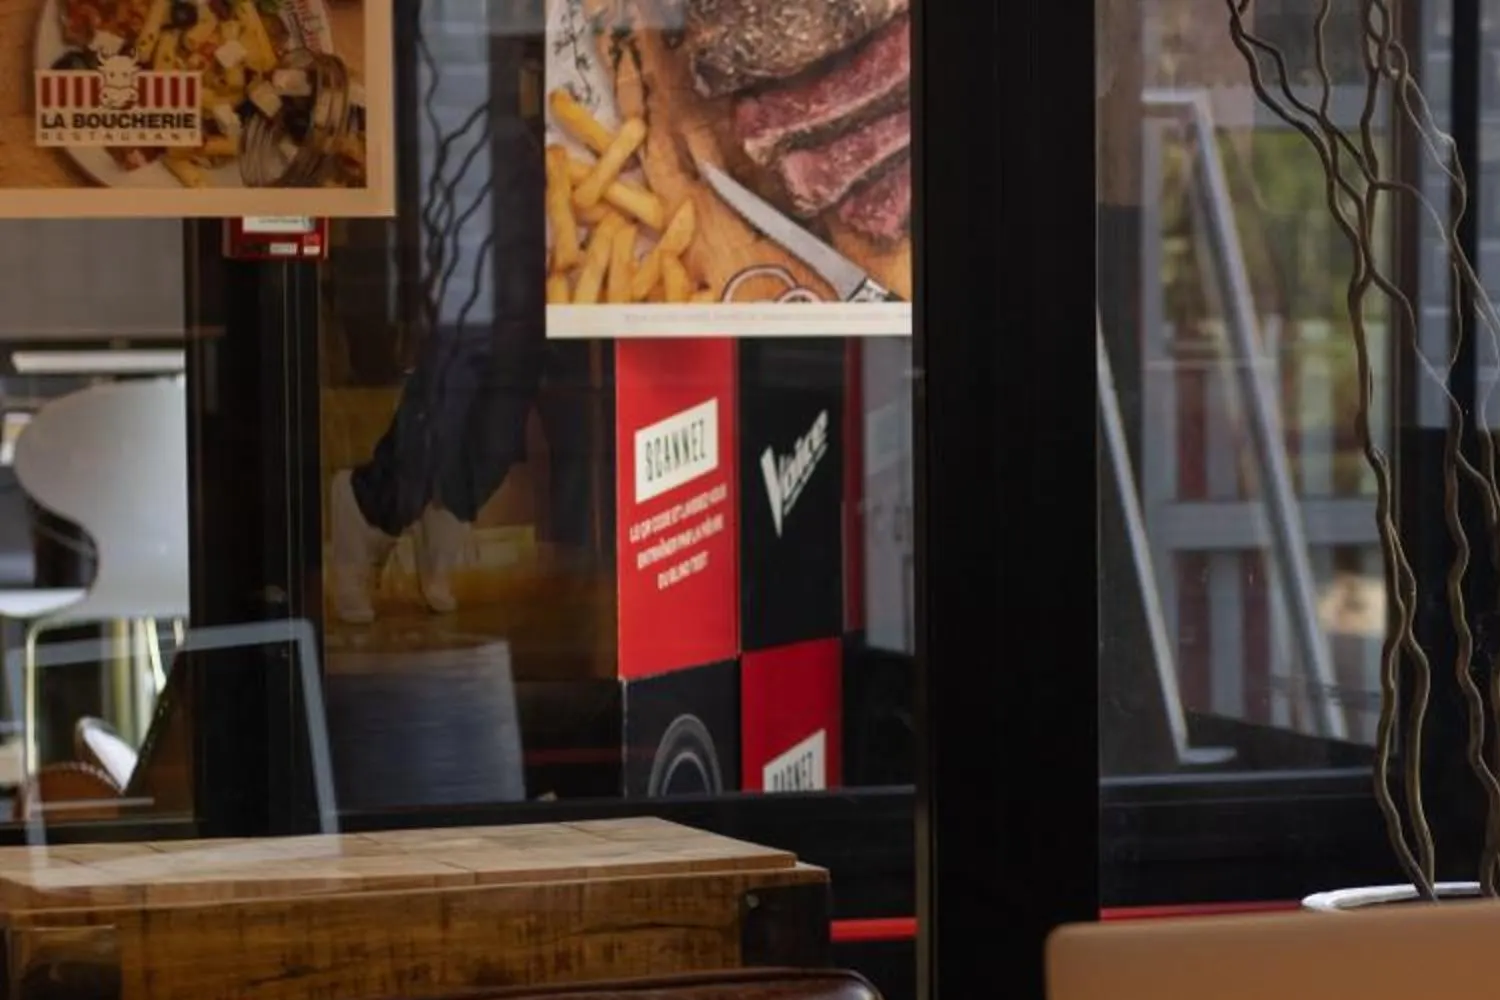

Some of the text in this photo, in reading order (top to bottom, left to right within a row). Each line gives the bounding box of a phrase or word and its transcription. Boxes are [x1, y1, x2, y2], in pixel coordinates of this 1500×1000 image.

[40, 112, 197, 129] LA BOUCHERIE
[41, 131, 197, 142] RESTAURANT
[645, 417, 706, 482] SCANNEZ
